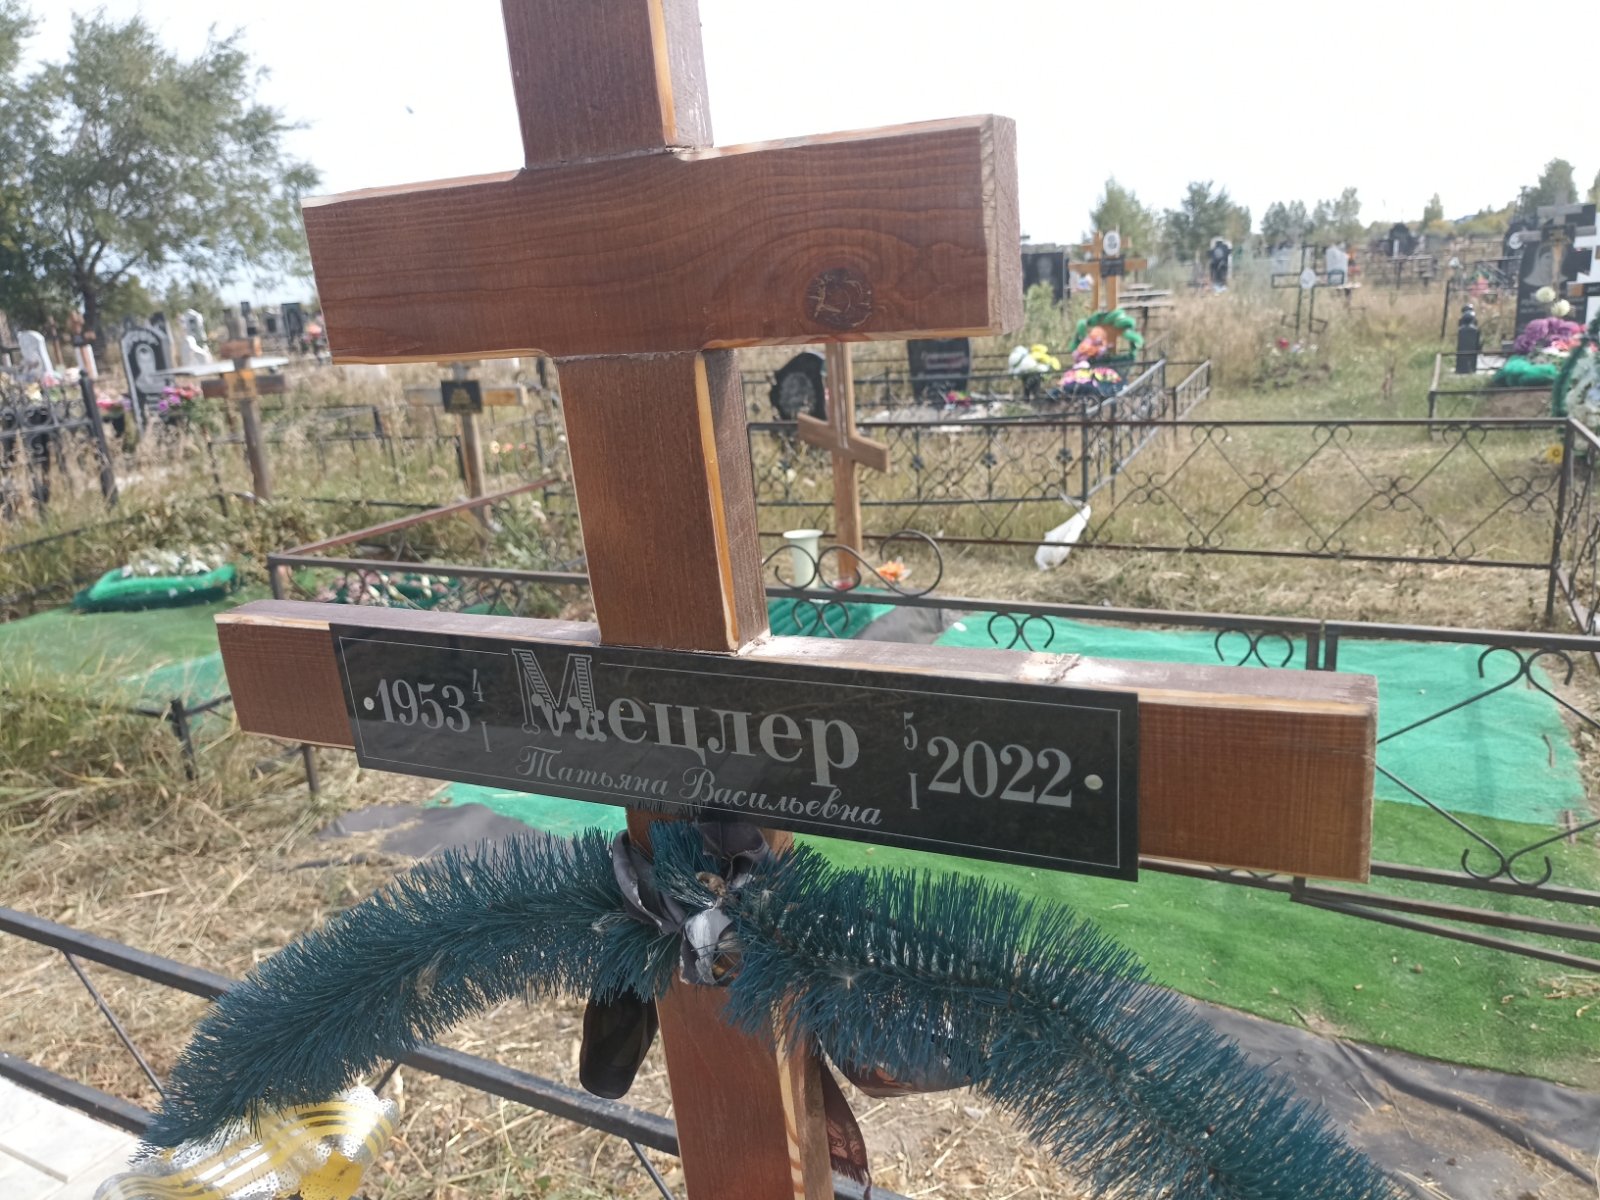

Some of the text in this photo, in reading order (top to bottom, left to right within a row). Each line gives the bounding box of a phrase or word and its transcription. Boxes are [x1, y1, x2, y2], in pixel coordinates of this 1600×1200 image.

[375, 678, 471, 733] 1953
[472, 668, 486, 703] 4
[511, 648, 860, 788] Мецлер
[903, 711, 919, 751] 5
[515, 745, 883, 826] Татьяна Васильевна
[926, 736, 1073, 809] 2022
